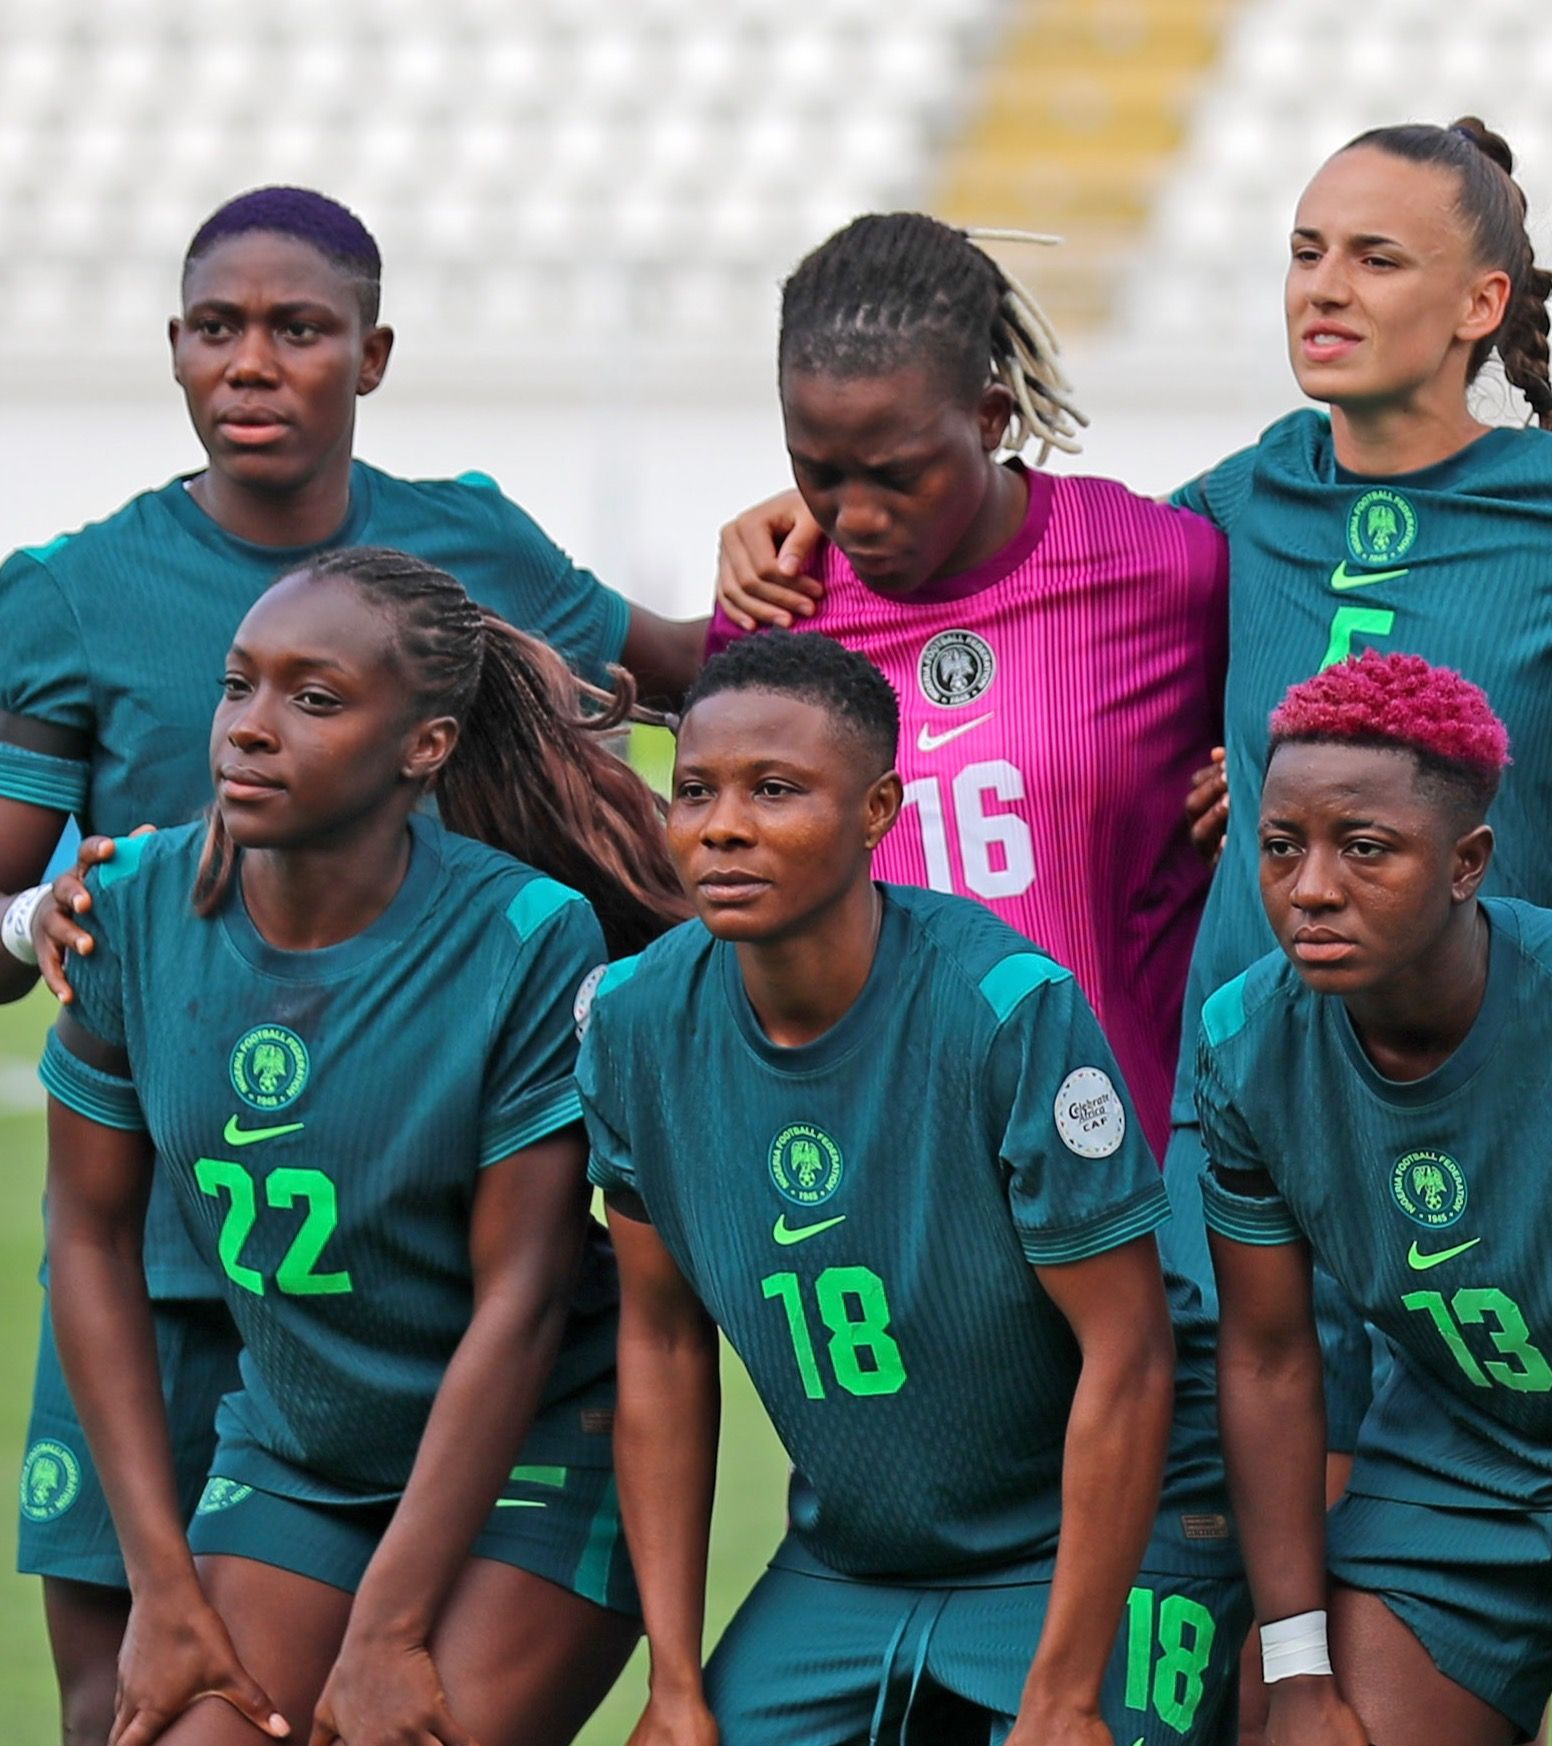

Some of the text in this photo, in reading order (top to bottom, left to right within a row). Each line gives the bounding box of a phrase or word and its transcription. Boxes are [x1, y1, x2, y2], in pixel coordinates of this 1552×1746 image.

[898, 759, 1036, 899] 16
[239, 1028, 286, 1053] FOOTBALL
[775, 1126, 817, 1150] FOOTBALL
[816, 1132, 840, 1192] FEDERATION
[1083, 1116, 1108, 1132] CAF
[194, 1158, 353, 1297] 22
[1393, 1151, 1465, 1215] NIGERIA FOOTBALL FEDERATION
[761, 1266, 908, 1400] 18
[1125, 1586, 1217, 1735] 18
